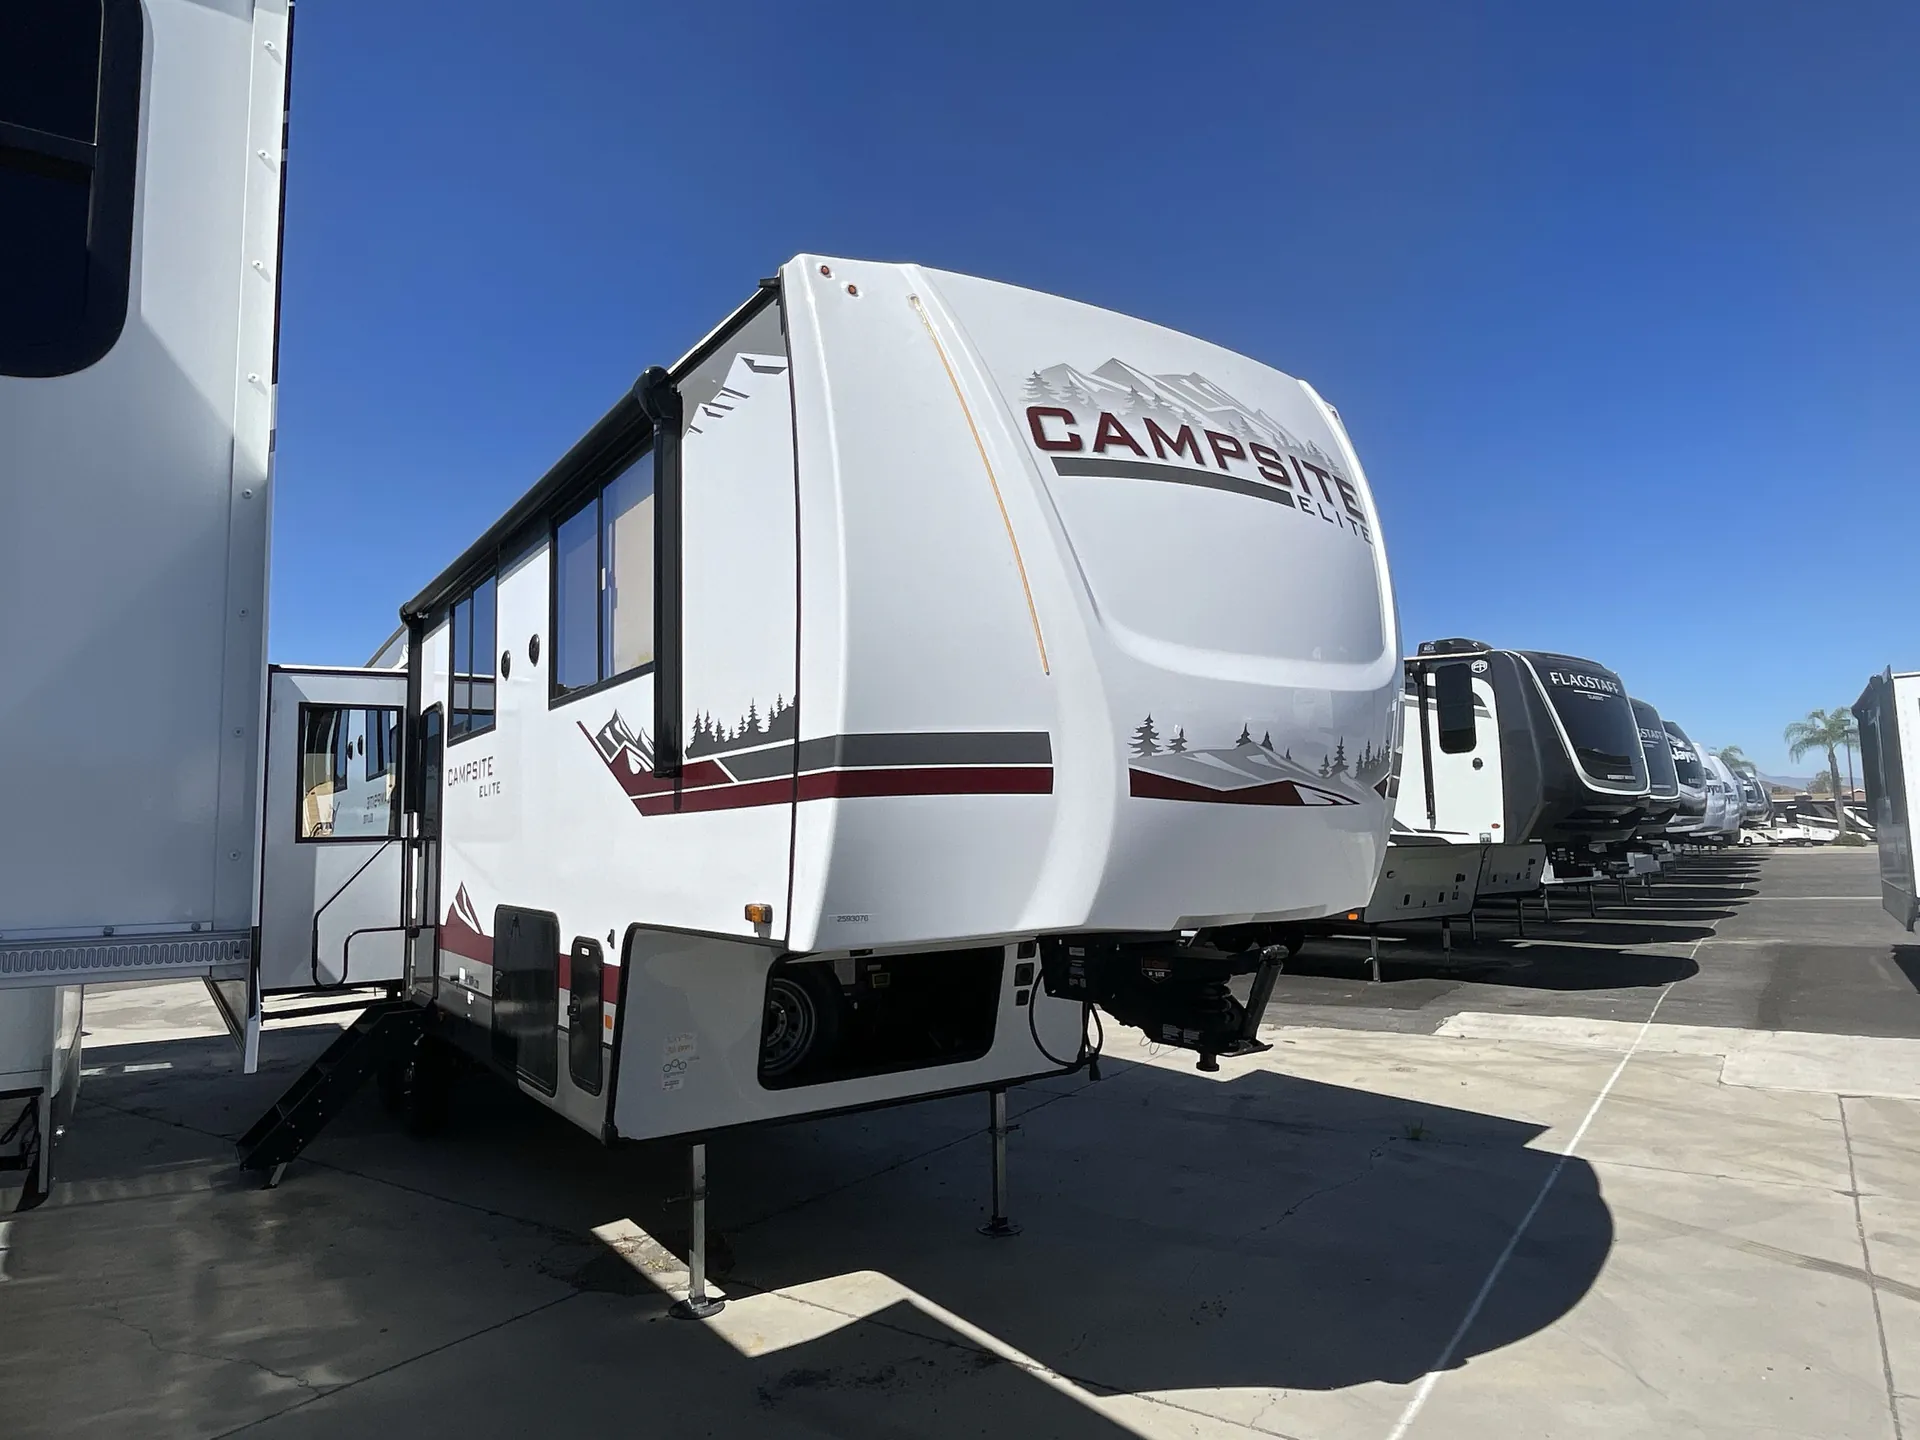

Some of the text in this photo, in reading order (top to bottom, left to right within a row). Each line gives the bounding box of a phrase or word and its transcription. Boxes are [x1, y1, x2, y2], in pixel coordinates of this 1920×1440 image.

[1025, 405, 1368, 524] CAMPSITE
[1297, 493, 1374, 546] ELITE
[1550, 671, 1620, 695] FLAGSTAFF
[448, 756, 493, 786] CAMPSITE
[479, 781, 501, 797] ELITE
